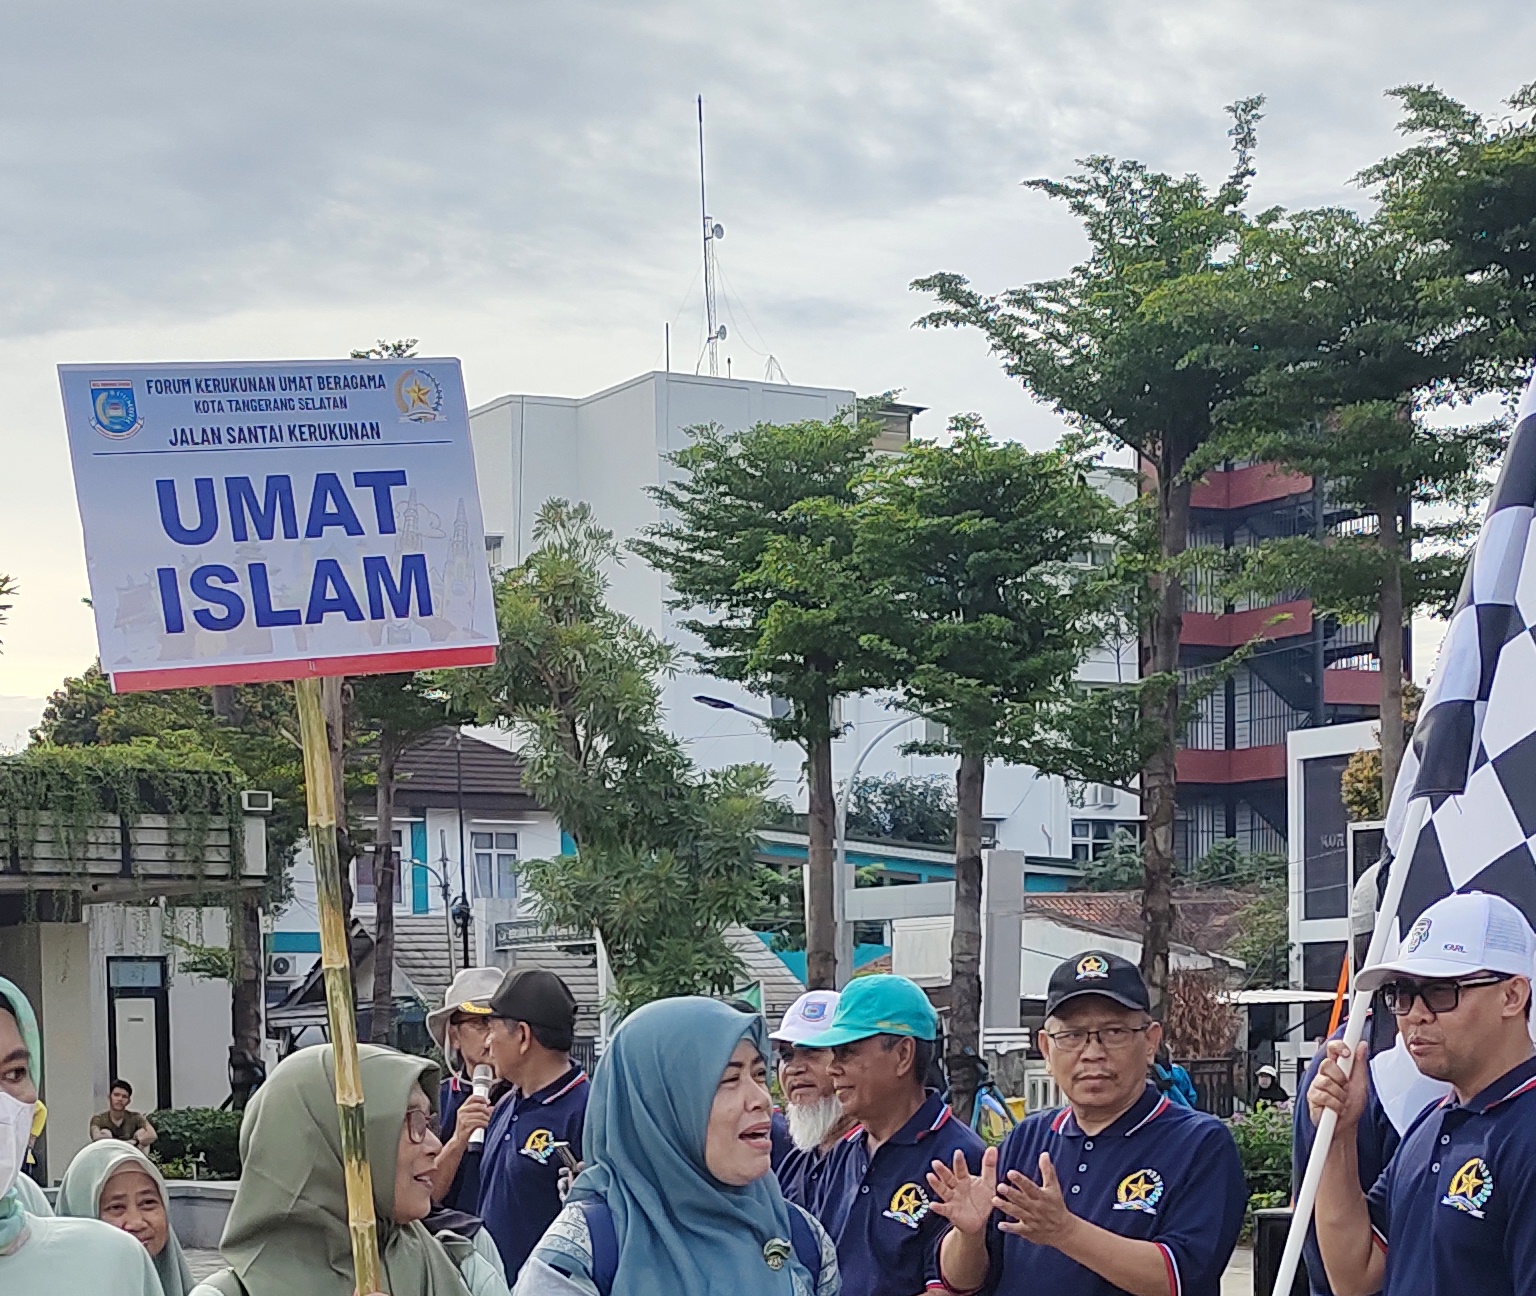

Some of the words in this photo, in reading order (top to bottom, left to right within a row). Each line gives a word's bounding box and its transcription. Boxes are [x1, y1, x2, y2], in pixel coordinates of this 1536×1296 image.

[146, 377, 192, 395] FORUM
[196, 375, 276, 393] KERUKUNAN
[279, 375, 314, 392] UMAT
[318, 373, 387, 391] BERAGAMA
[194, 398, 225, 414] KOTA
[227, 396, 296, 412] TANGERANG
[298, 395, 347, 411] SELATAN
[169, 427, 223, 446] JALAN
[227, 424, 283, 444] SANTAI
[288, 421, 381, 442] KERUKUNAN
[155, 469, 408, 546] UMAT
[156, 553, 434, 634] ISLAM
